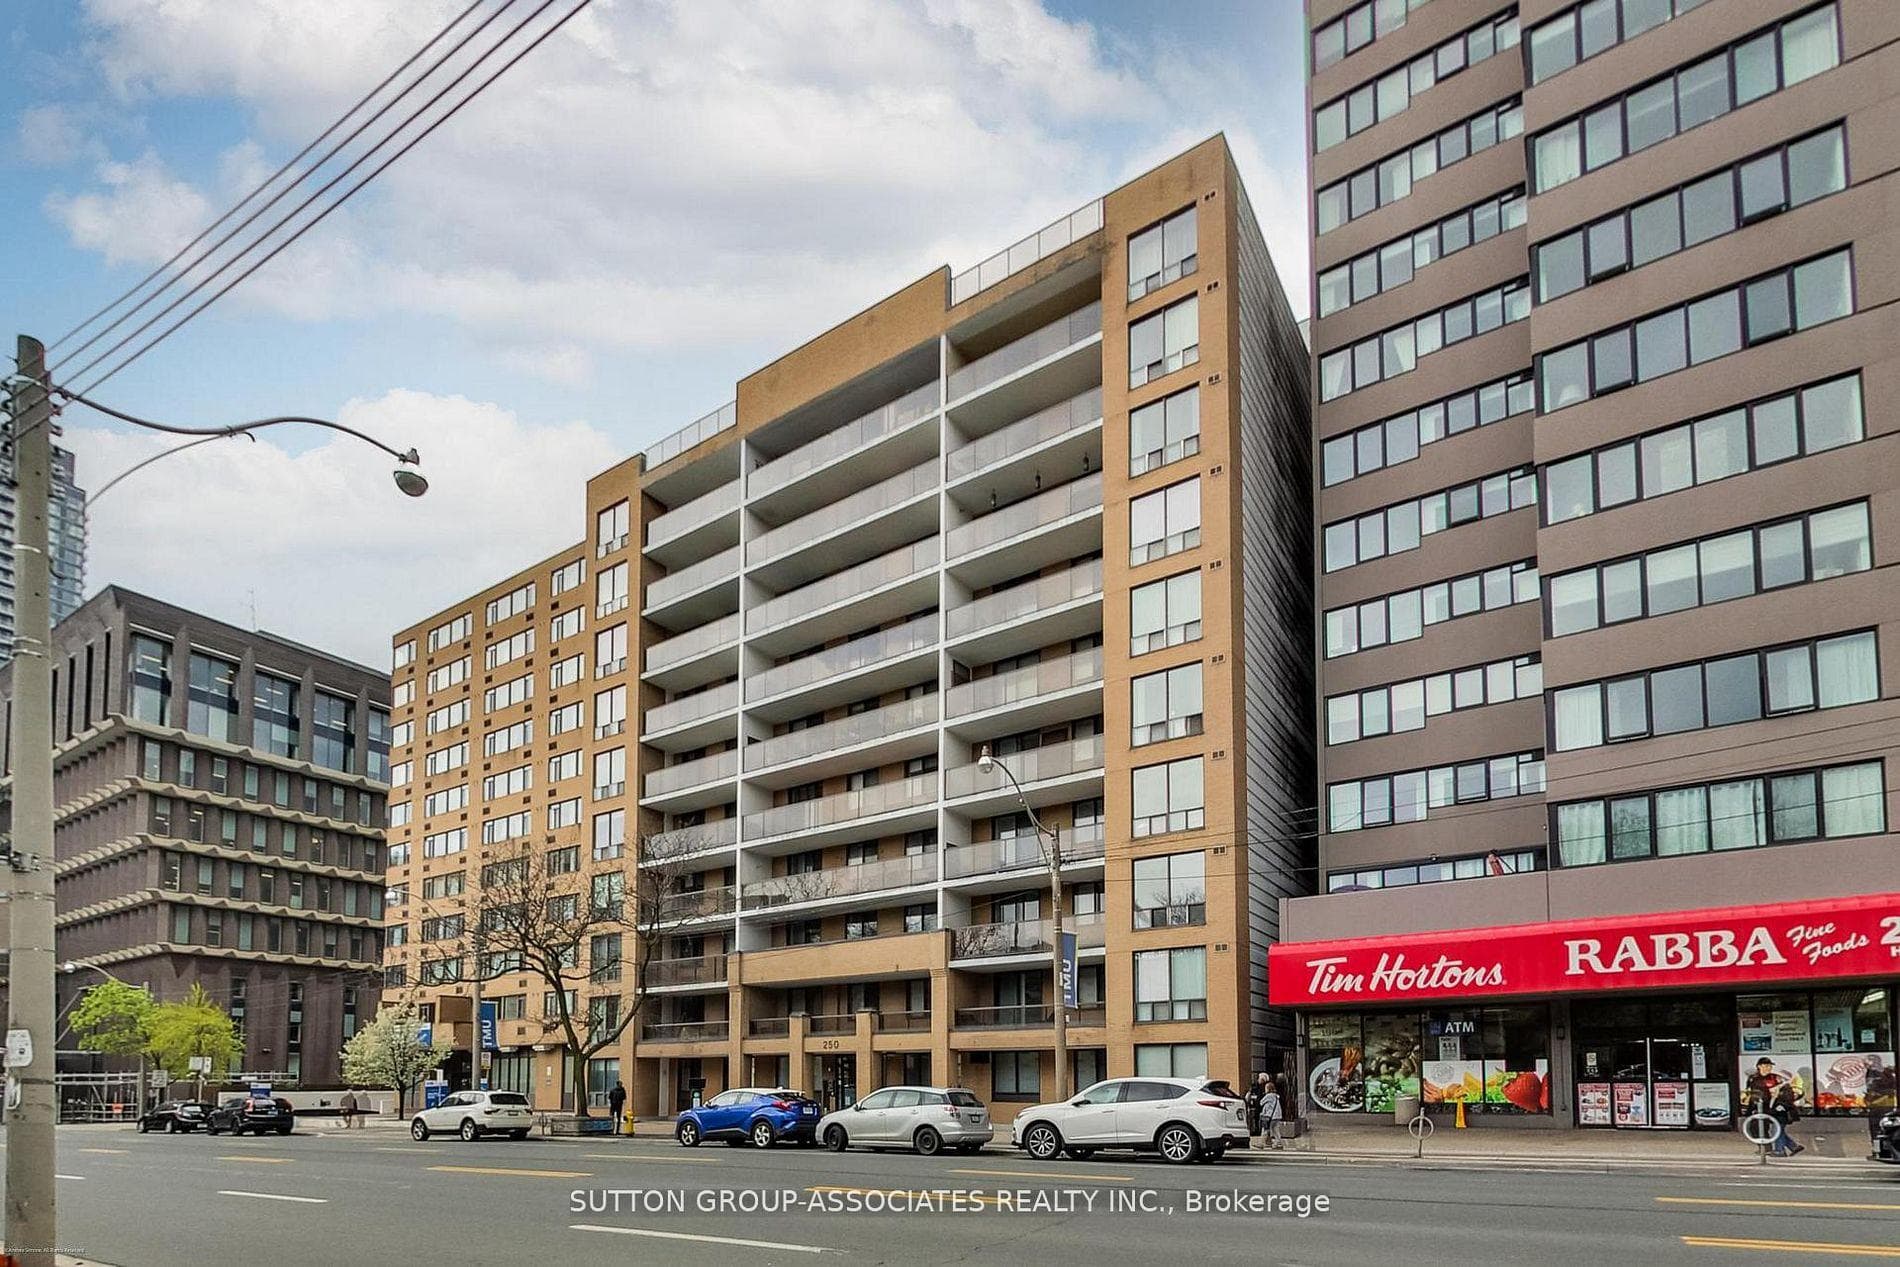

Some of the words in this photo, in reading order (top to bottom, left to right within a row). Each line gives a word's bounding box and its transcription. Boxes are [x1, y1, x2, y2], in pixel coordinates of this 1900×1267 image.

[1786, 920, 1836, 947] Fine
[1802, 932, 1870, 965] Foods
[1563, 926, 1787, 975] RABBA
[1306, 956, 1365, 995] Tim
[1369, 952, 1505, 992] Hortons
[482, 1019, 492, 1049] TMU
[1444, 1021, 1475, 1034] ATM
[822, 1040, 840, 1050] 250
